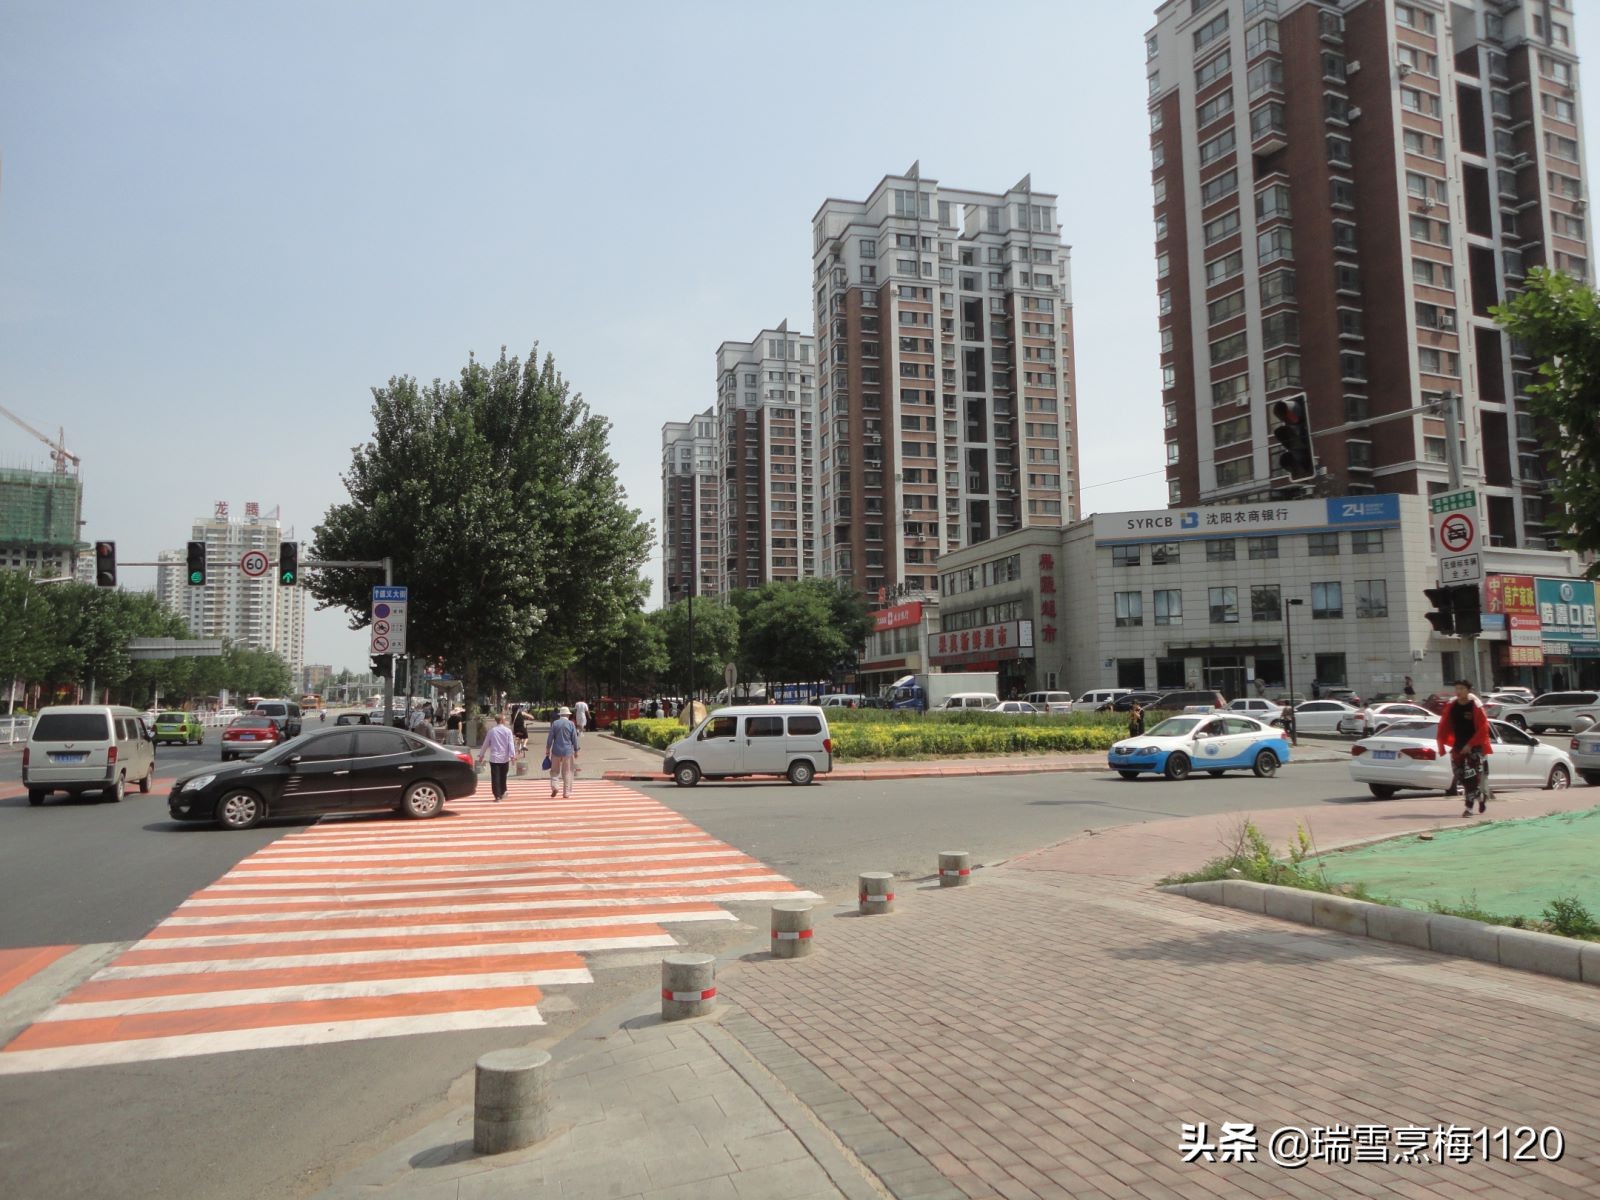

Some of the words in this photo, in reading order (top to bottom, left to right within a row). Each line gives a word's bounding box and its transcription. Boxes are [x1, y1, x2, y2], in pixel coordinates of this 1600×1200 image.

[215, 501, 259, 516] 龙腾
[1127, 516, 1173, 530] SYRCB
[1206, 508, 1289, 525] 沈阳农商银行
[246, 558, 263, 570] 60
[1488, 578, 1502, 612] 中介
